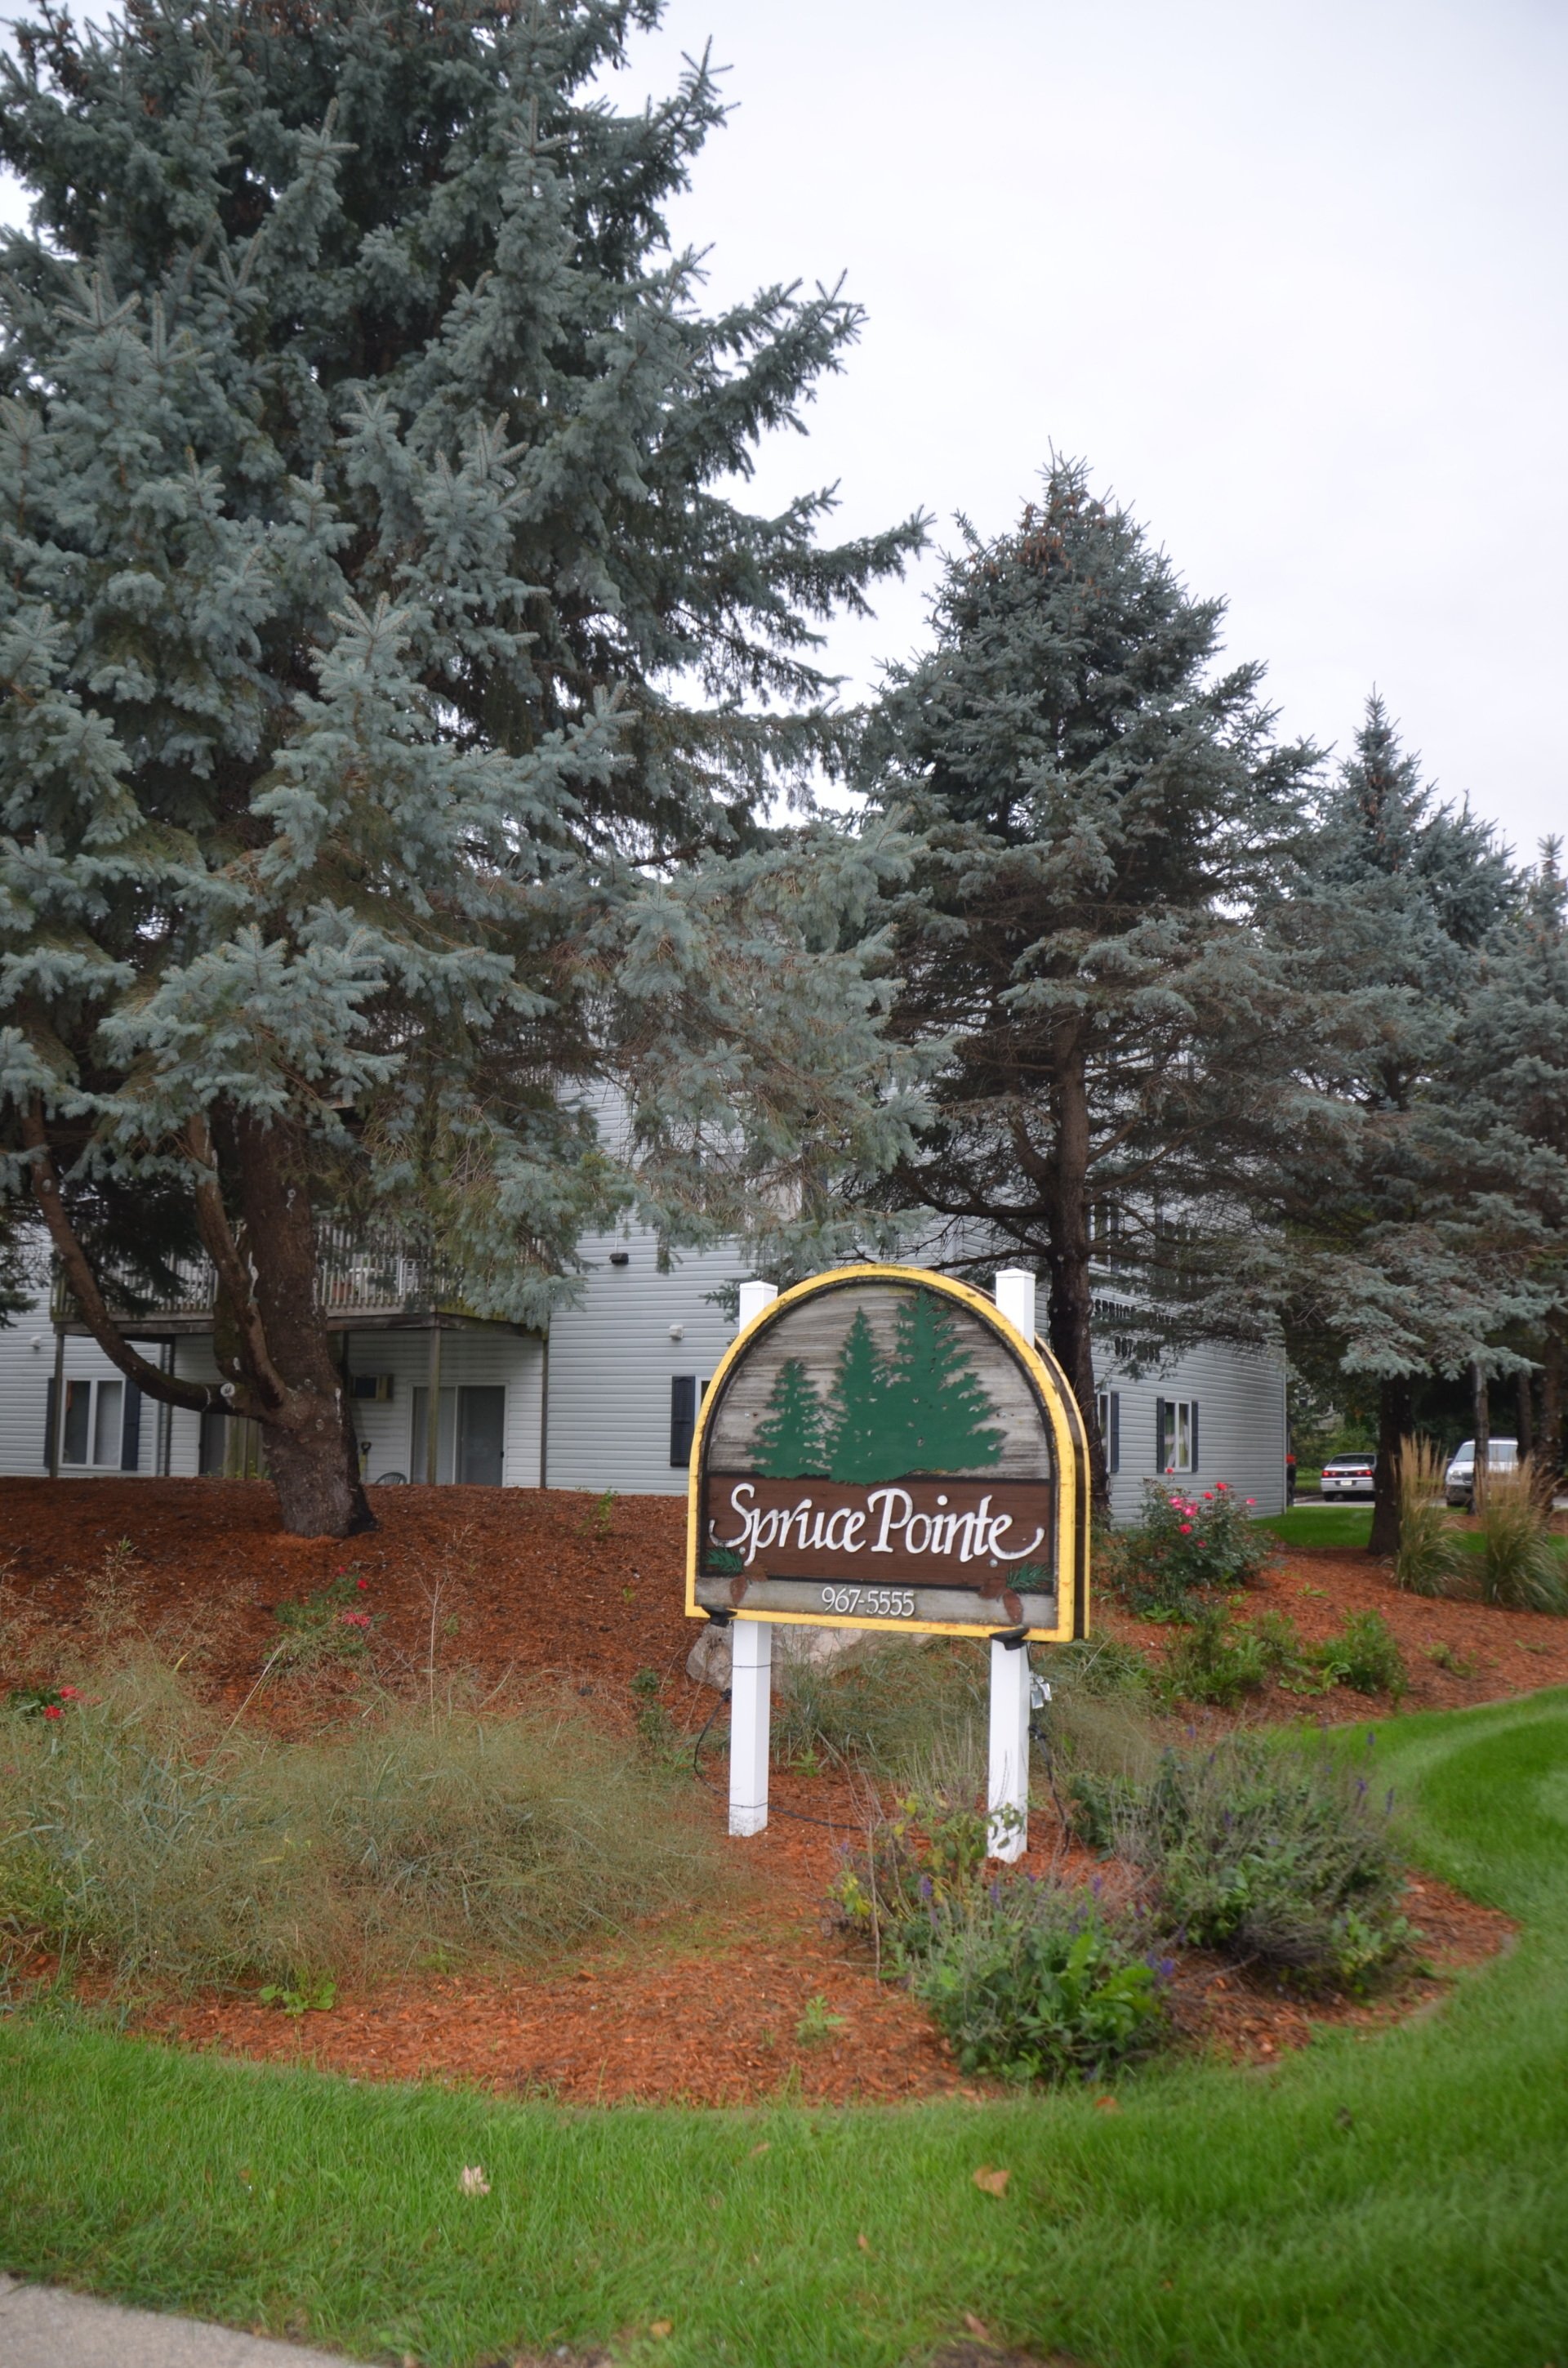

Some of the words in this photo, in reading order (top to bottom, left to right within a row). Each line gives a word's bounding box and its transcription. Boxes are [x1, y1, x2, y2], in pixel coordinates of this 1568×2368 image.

[709, 1483, 867, 1567] Spruce
[867, 1487, 1045, 1563] Pointe
[821, 1586, 915, 1617] 967-5555
